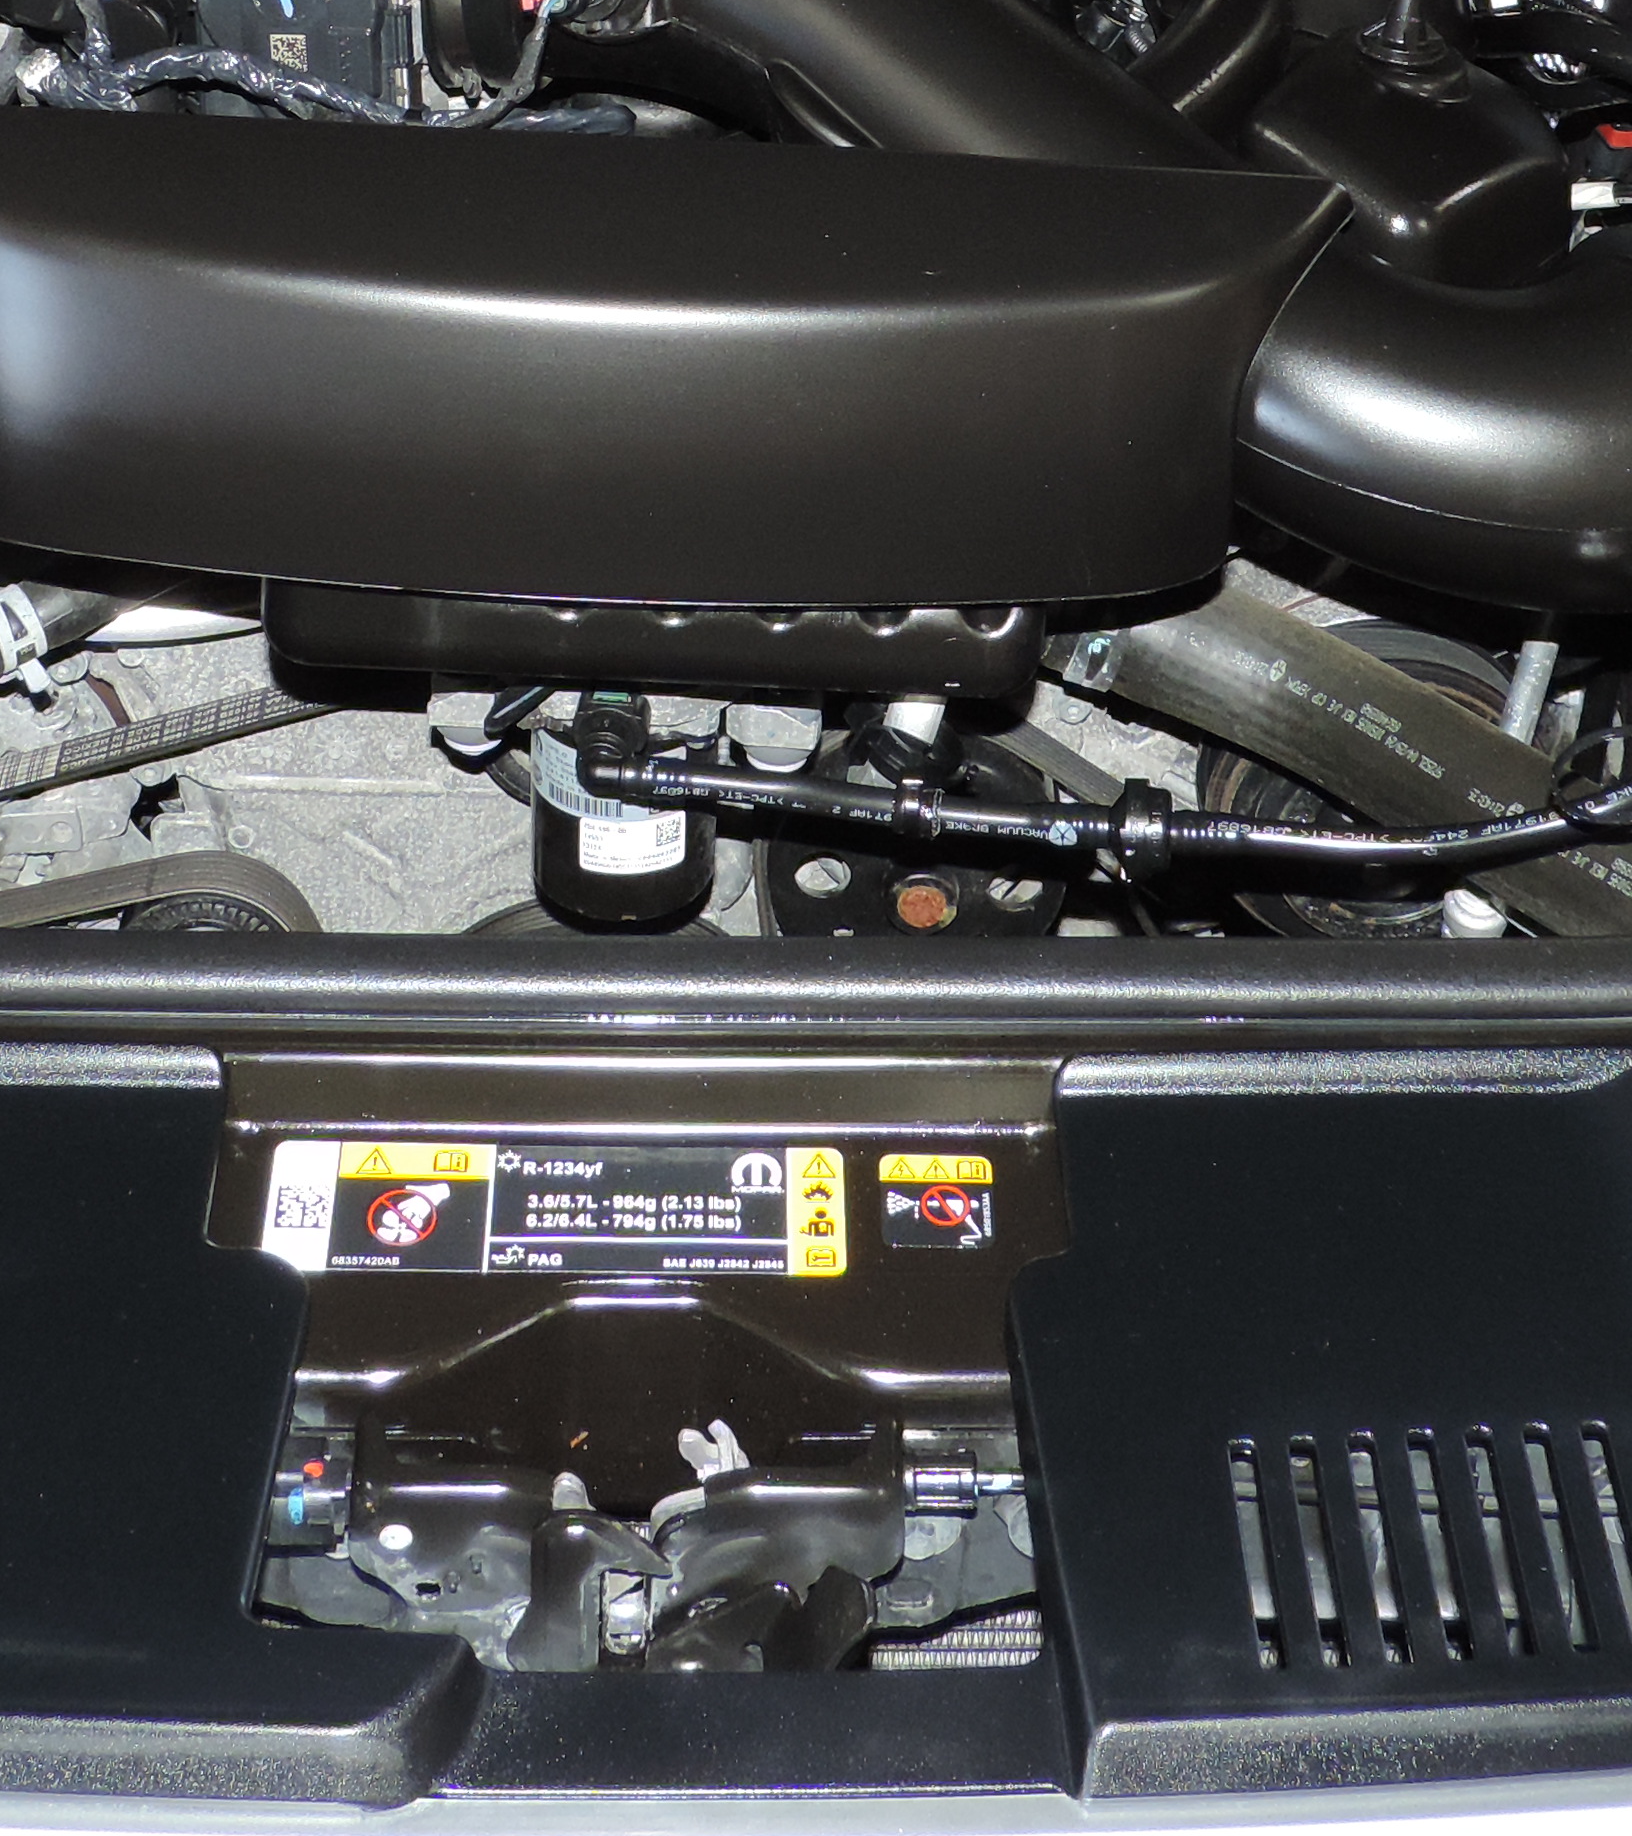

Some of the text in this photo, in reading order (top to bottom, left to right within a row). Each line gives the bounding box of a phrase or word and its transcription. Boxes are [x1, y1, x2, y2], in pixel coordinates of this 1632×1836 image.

[945, 820, 990, 835] BRAKE
[997, 824, 1052, 842] VACUUM
[522, 1161, 604, 1178] R-1234yf
[527, 1194, 598, 1210] 3.6/5.7L
[612, 1195, 656, 1213] 964g
[661, 1195, 704, 1212] (2.13
[708, 1195, 742, 1213] lbs)
[525, 1213, 598, 1228] 6.2/6.4L
[612, 1214, 656, 1232] 794g
[661, 1214, 704, 1231] (1.75
[708, 1214, 742, 1233] lbs)
[527, 1253, 563, 1266] PAG
